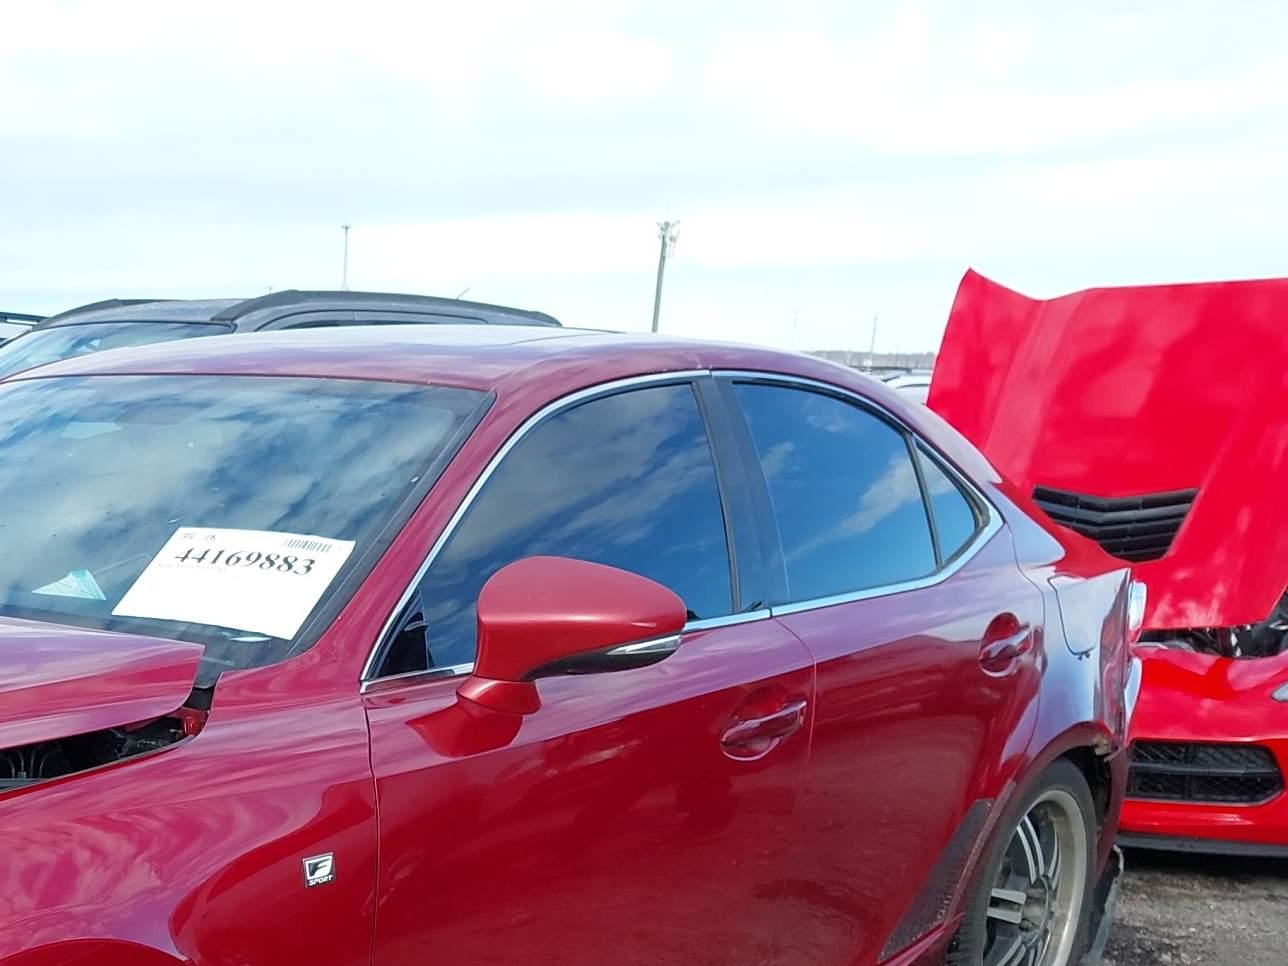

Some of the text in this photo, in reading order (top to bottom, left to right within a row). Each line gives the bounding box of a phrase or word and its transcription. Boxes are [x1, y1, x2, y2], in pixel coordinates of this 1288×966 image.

[174, 547, 316, 576] 44169883
[307, 857, 332, 878] F
[308, 874, 334, 886] SPORT
